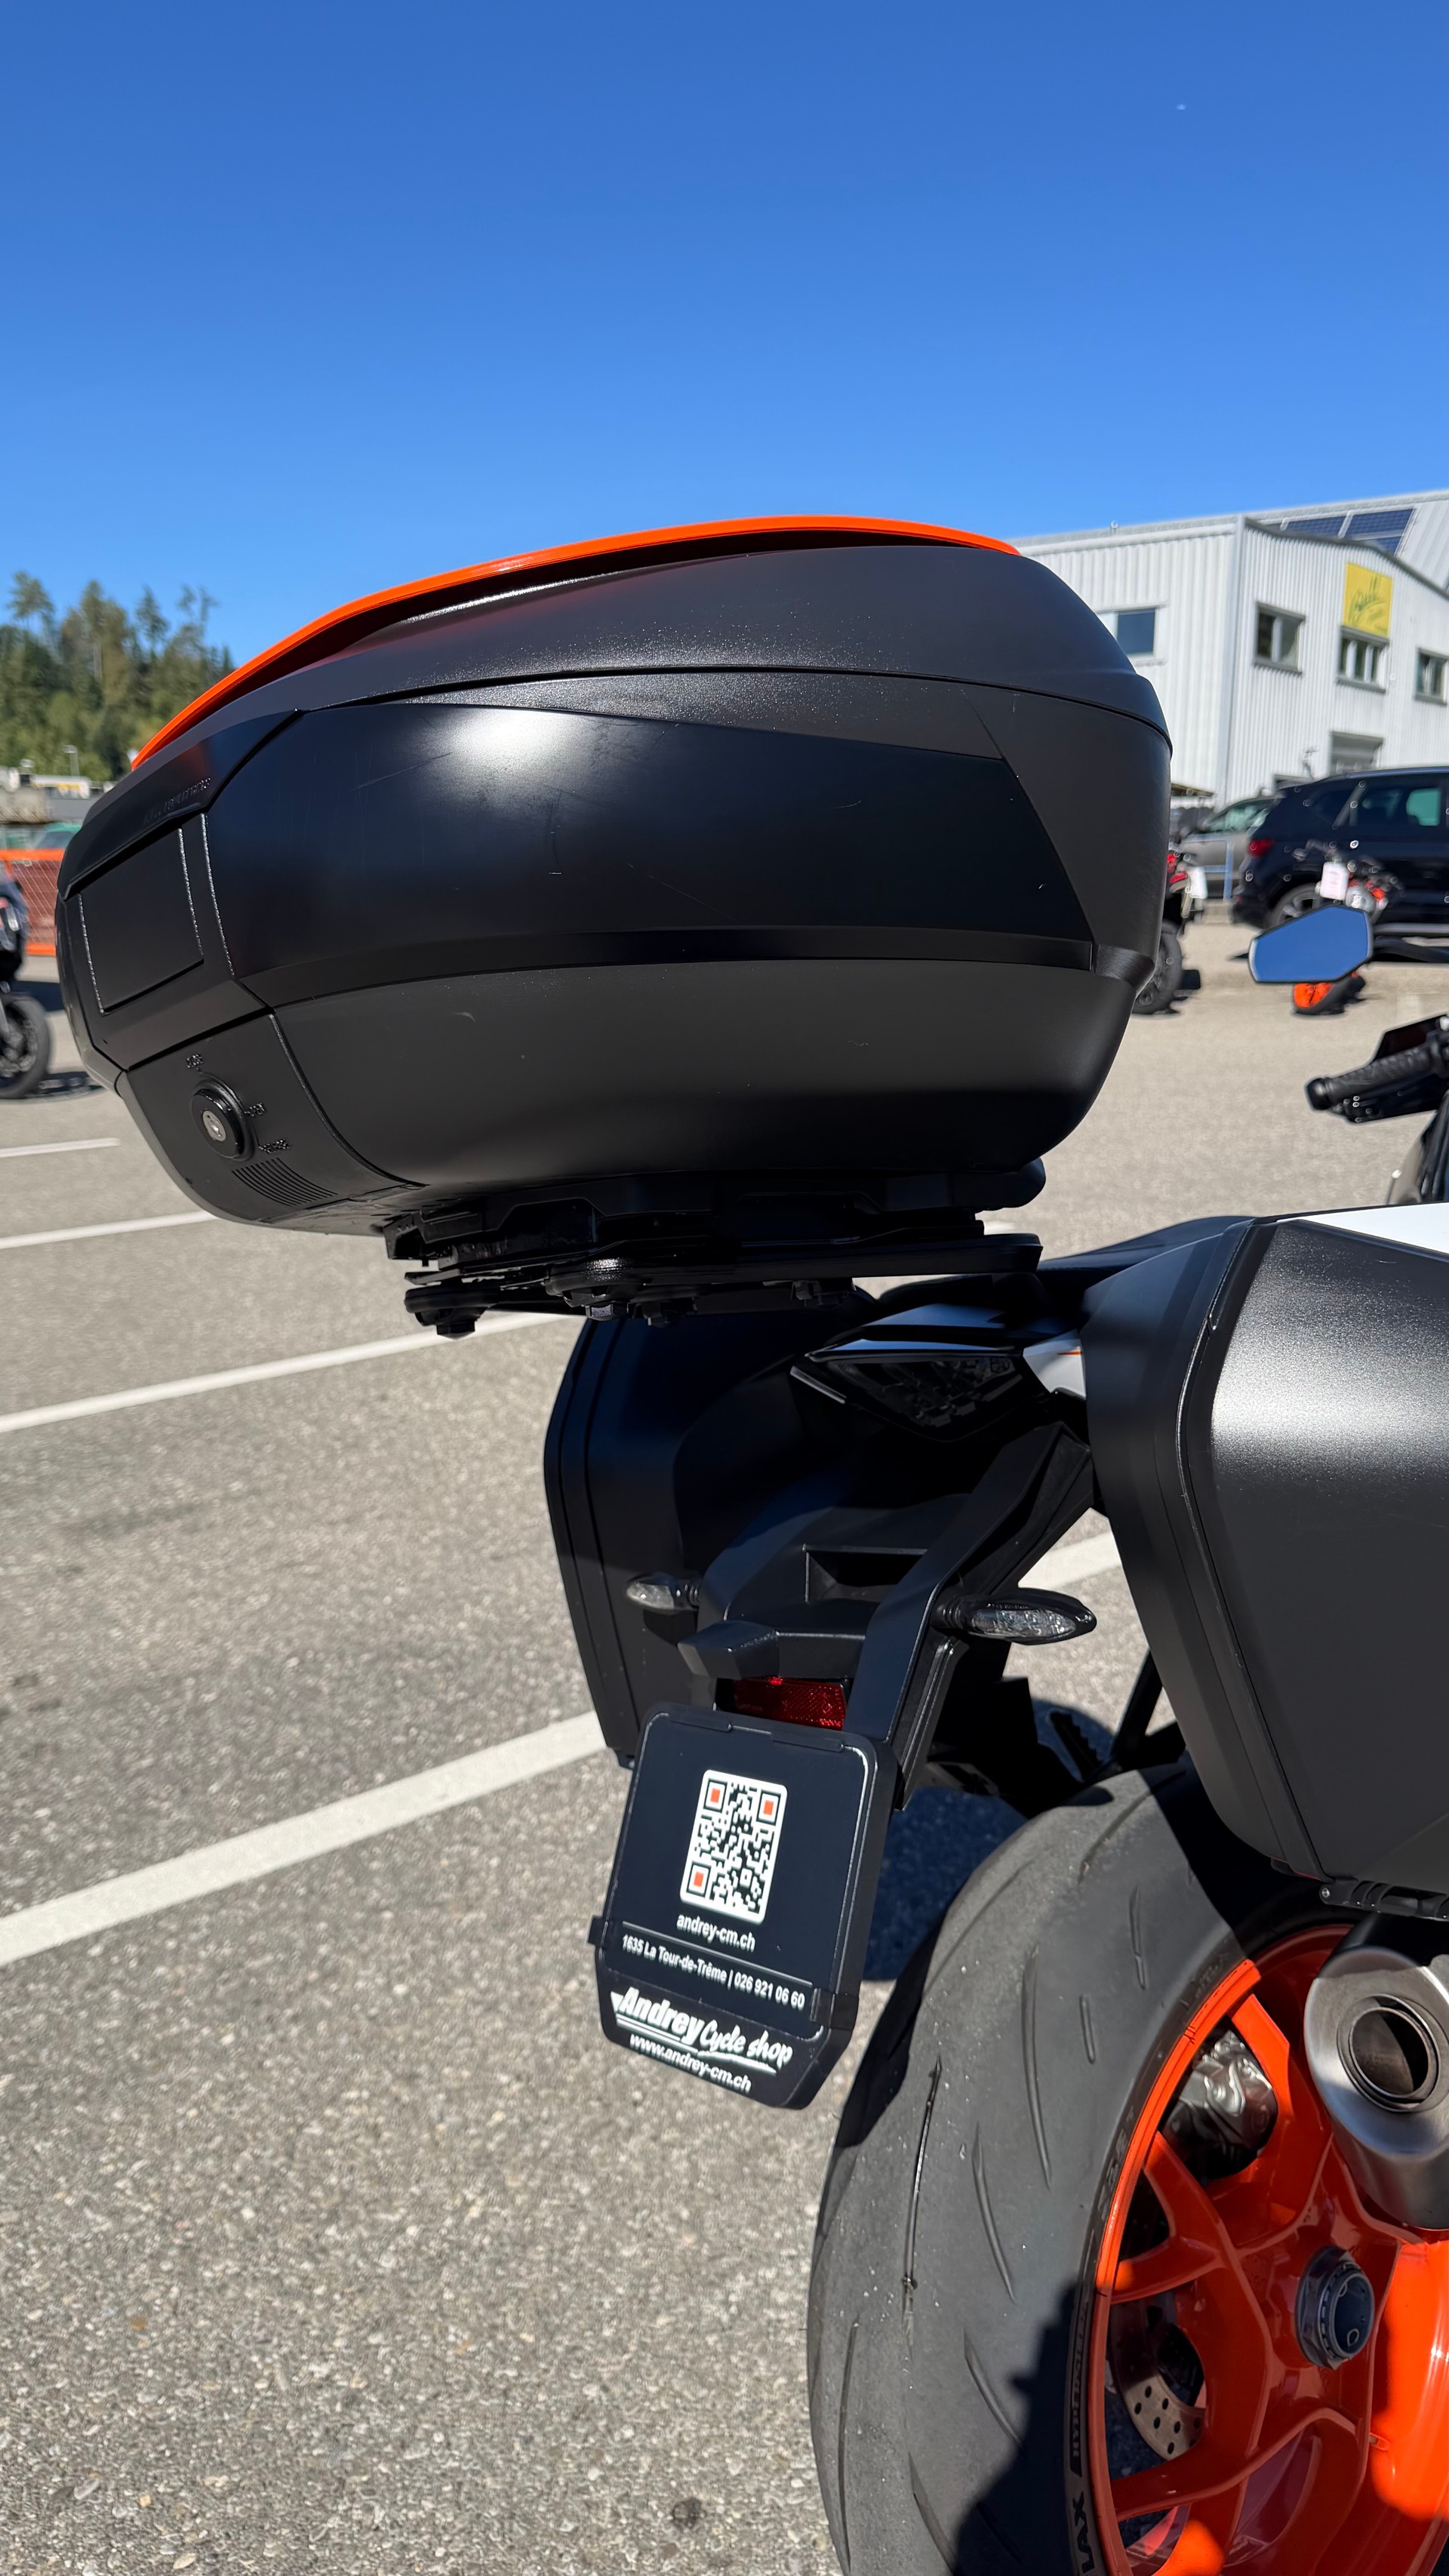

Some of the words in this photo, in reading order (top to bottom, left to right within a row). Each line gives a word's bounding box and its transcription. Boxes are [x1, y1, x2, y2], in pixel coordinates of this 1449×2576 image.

[677, 1914, 755, 1953] andrey-cm.ch
[622, 1934, 644, 1953] 1635
[644, 1941, 657, 1960] La
[658, 1946, 727, 1982] Tour-de-Trême
[734, 1971, 754, 1992] 026
[755, 1978, 773, 1999] 921
[775, 1986, 789, 2006] 06
[790, 1990, 805, 2011] 60
[616, 1987, 705, 2045] Andrey
[700, 2020, 746, 2052] Cycle
[746, 2030, 793, 2070] shop
[629, 2034, 752, 2094] www.andrey-cm.ch
[1072, 2491, 1094, 2576] LAX
